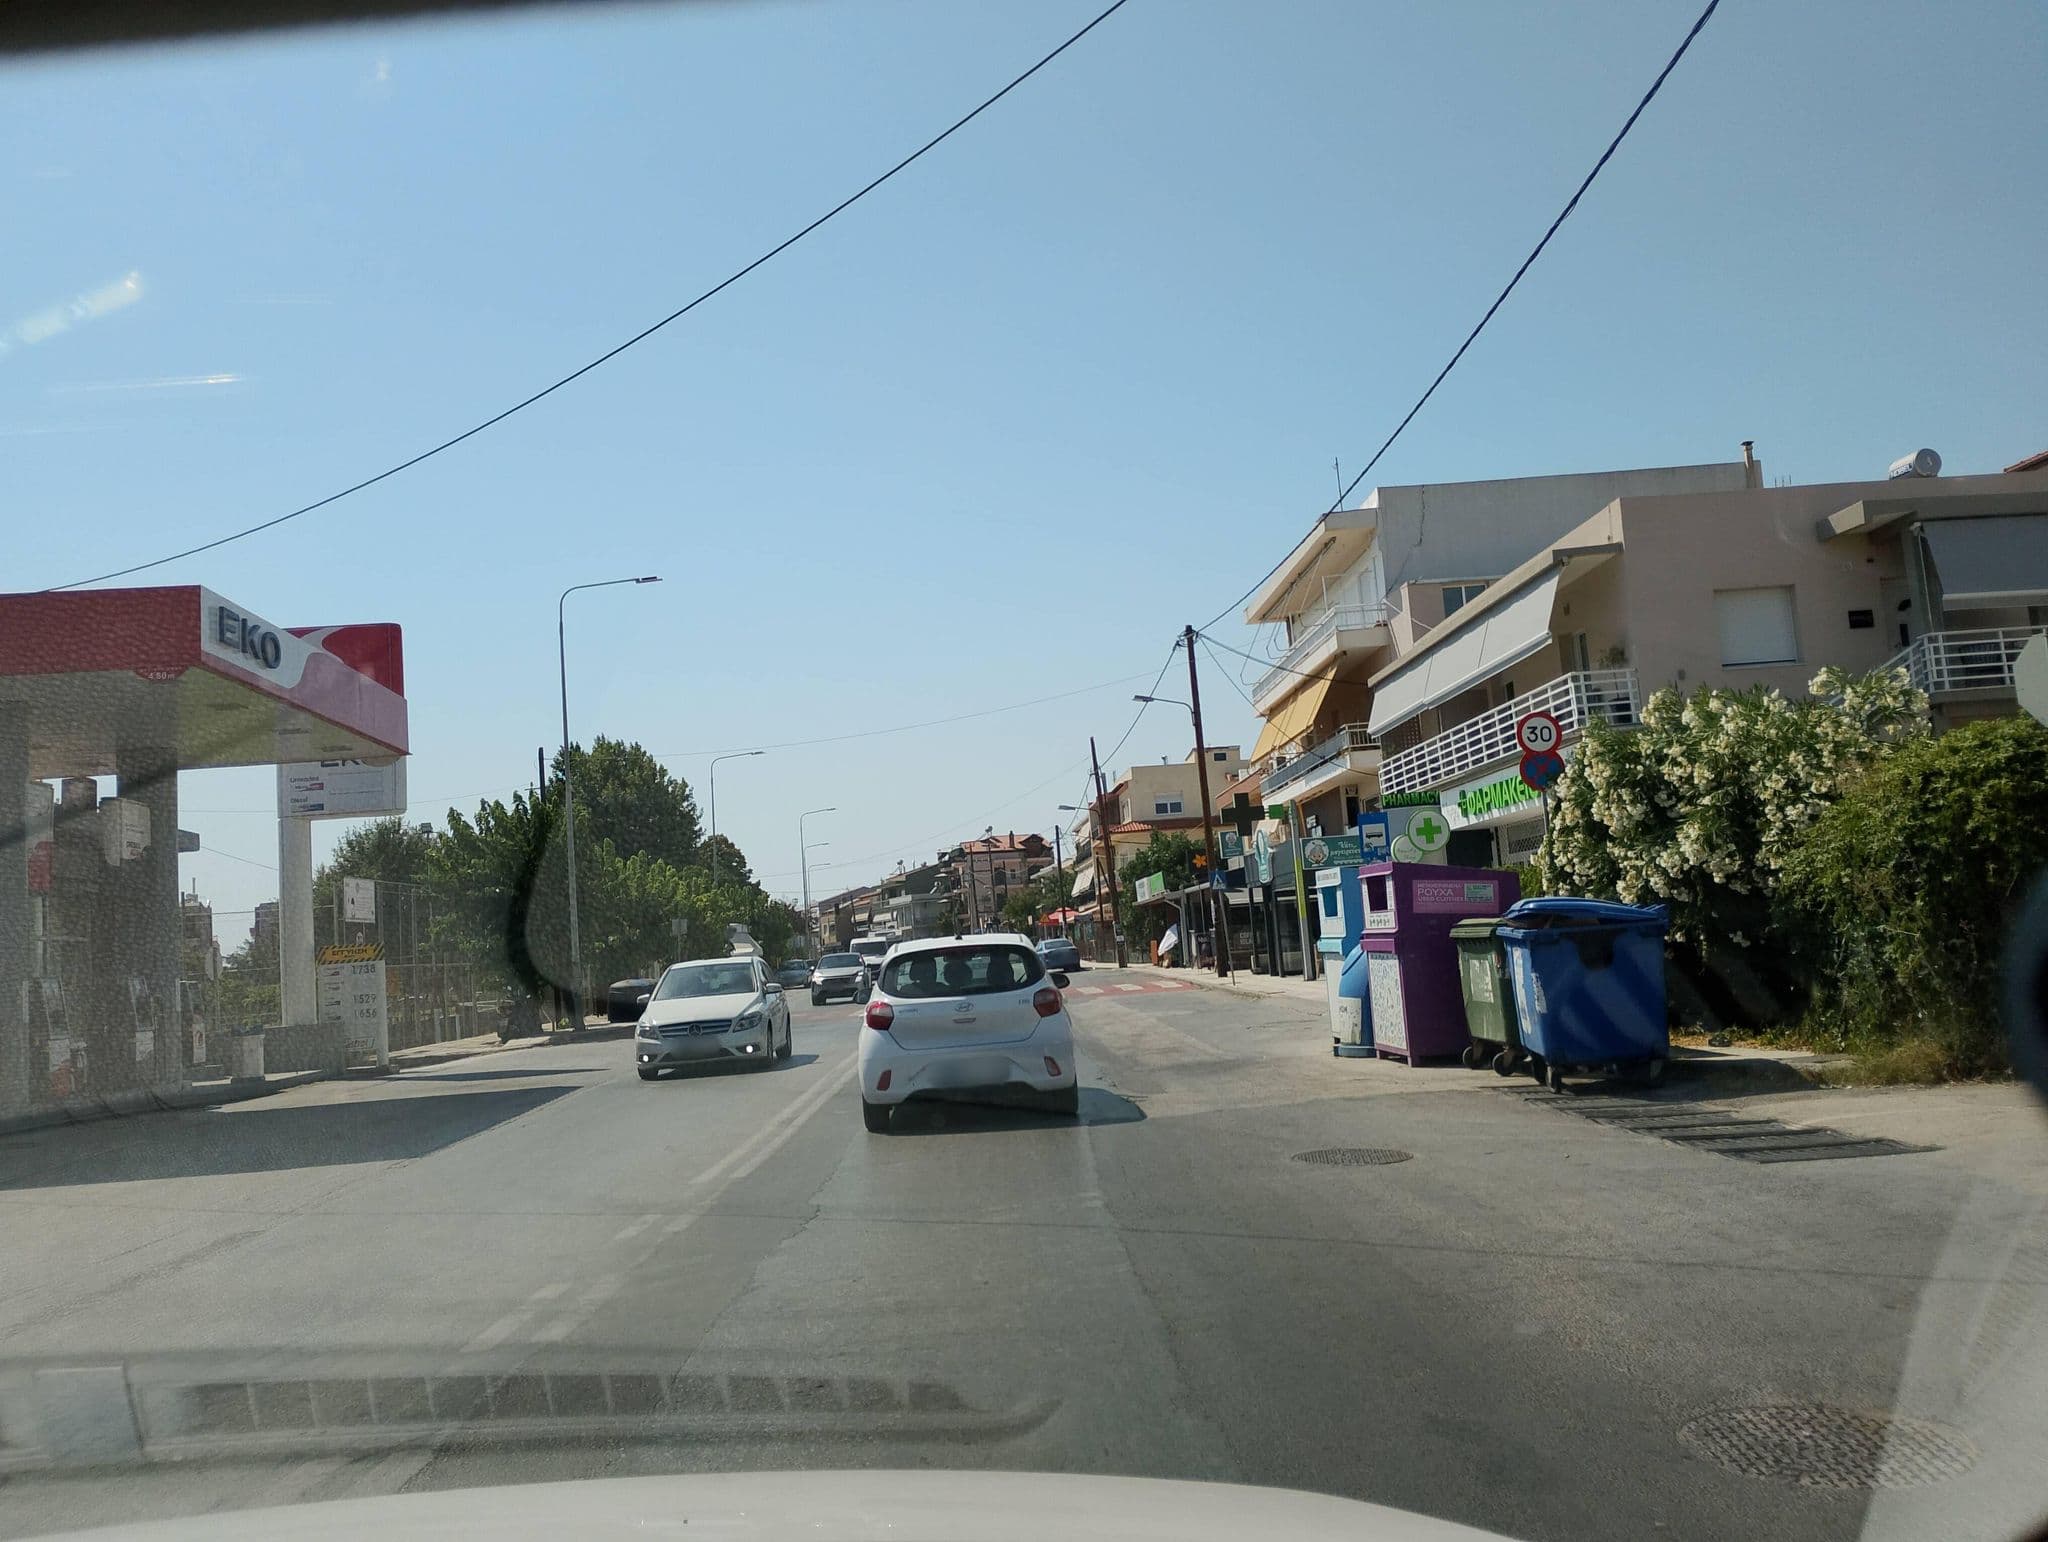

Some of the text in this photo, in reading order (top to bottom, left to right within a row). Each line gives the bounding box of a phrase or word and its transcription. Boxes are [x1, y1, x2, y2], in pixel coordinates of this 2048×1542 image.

[219, 606, 281, 669] EKO
[1527, 726, 1552, 743] 30
[1382, 790, 1440, 806] PHARMACY
[1417, 888, 1454, 897] ΡΟΥΧΑ
